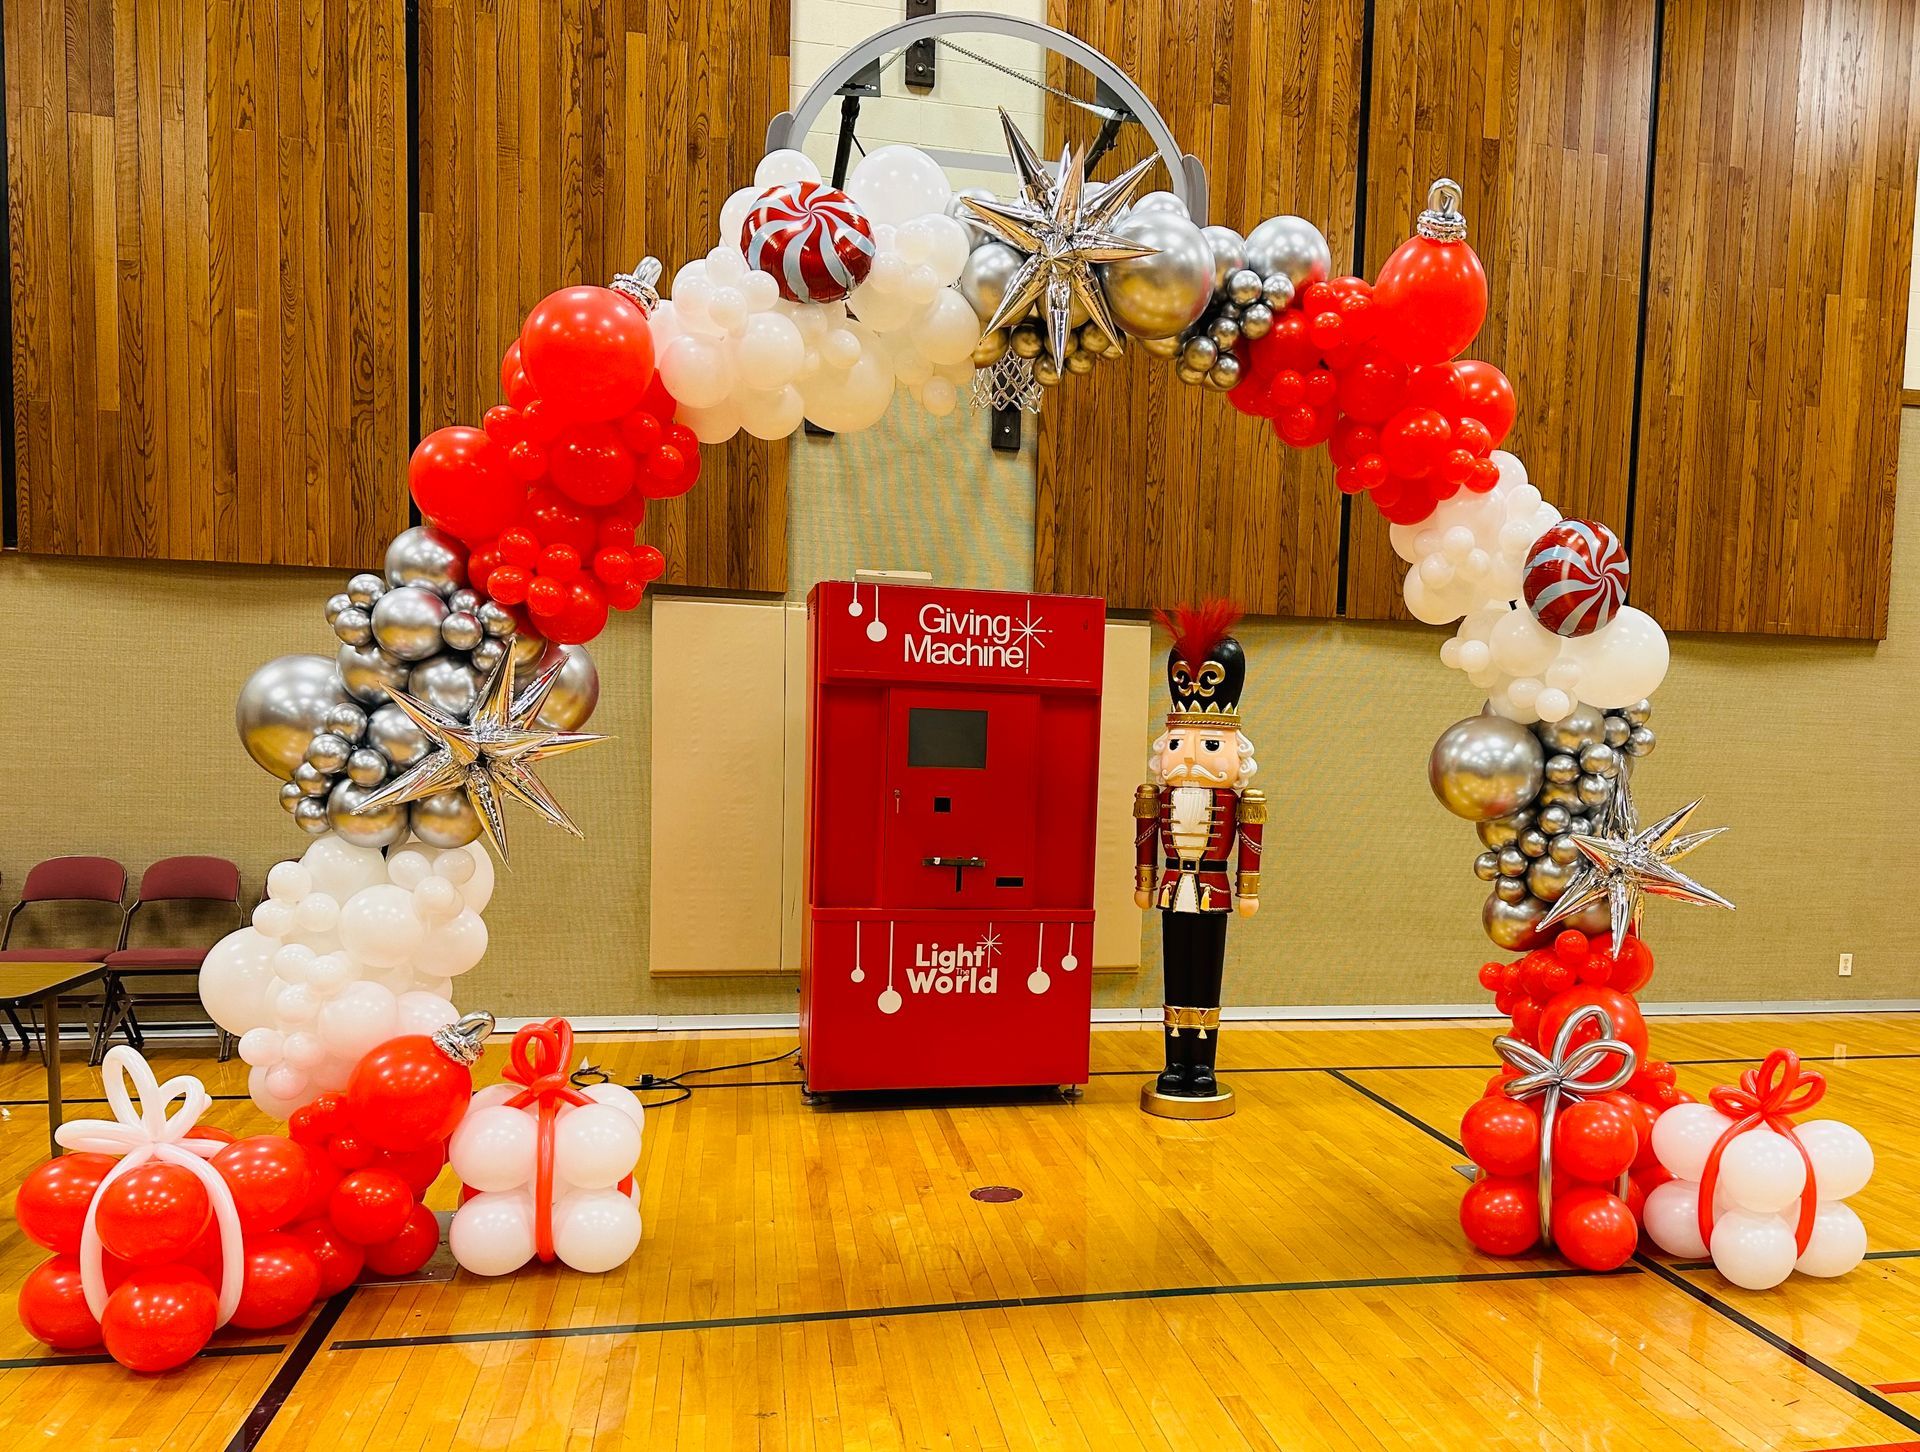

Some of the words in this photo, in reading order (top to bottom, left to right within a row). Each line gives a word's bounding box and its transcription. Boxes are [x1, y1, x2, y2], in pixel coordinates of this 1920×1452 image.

[918, 603, 1011, 644] Giving
[904, 633, 1024, 668] Machine
[915, 943, 986, 974] Light
[906, 967, 998, 994] World
